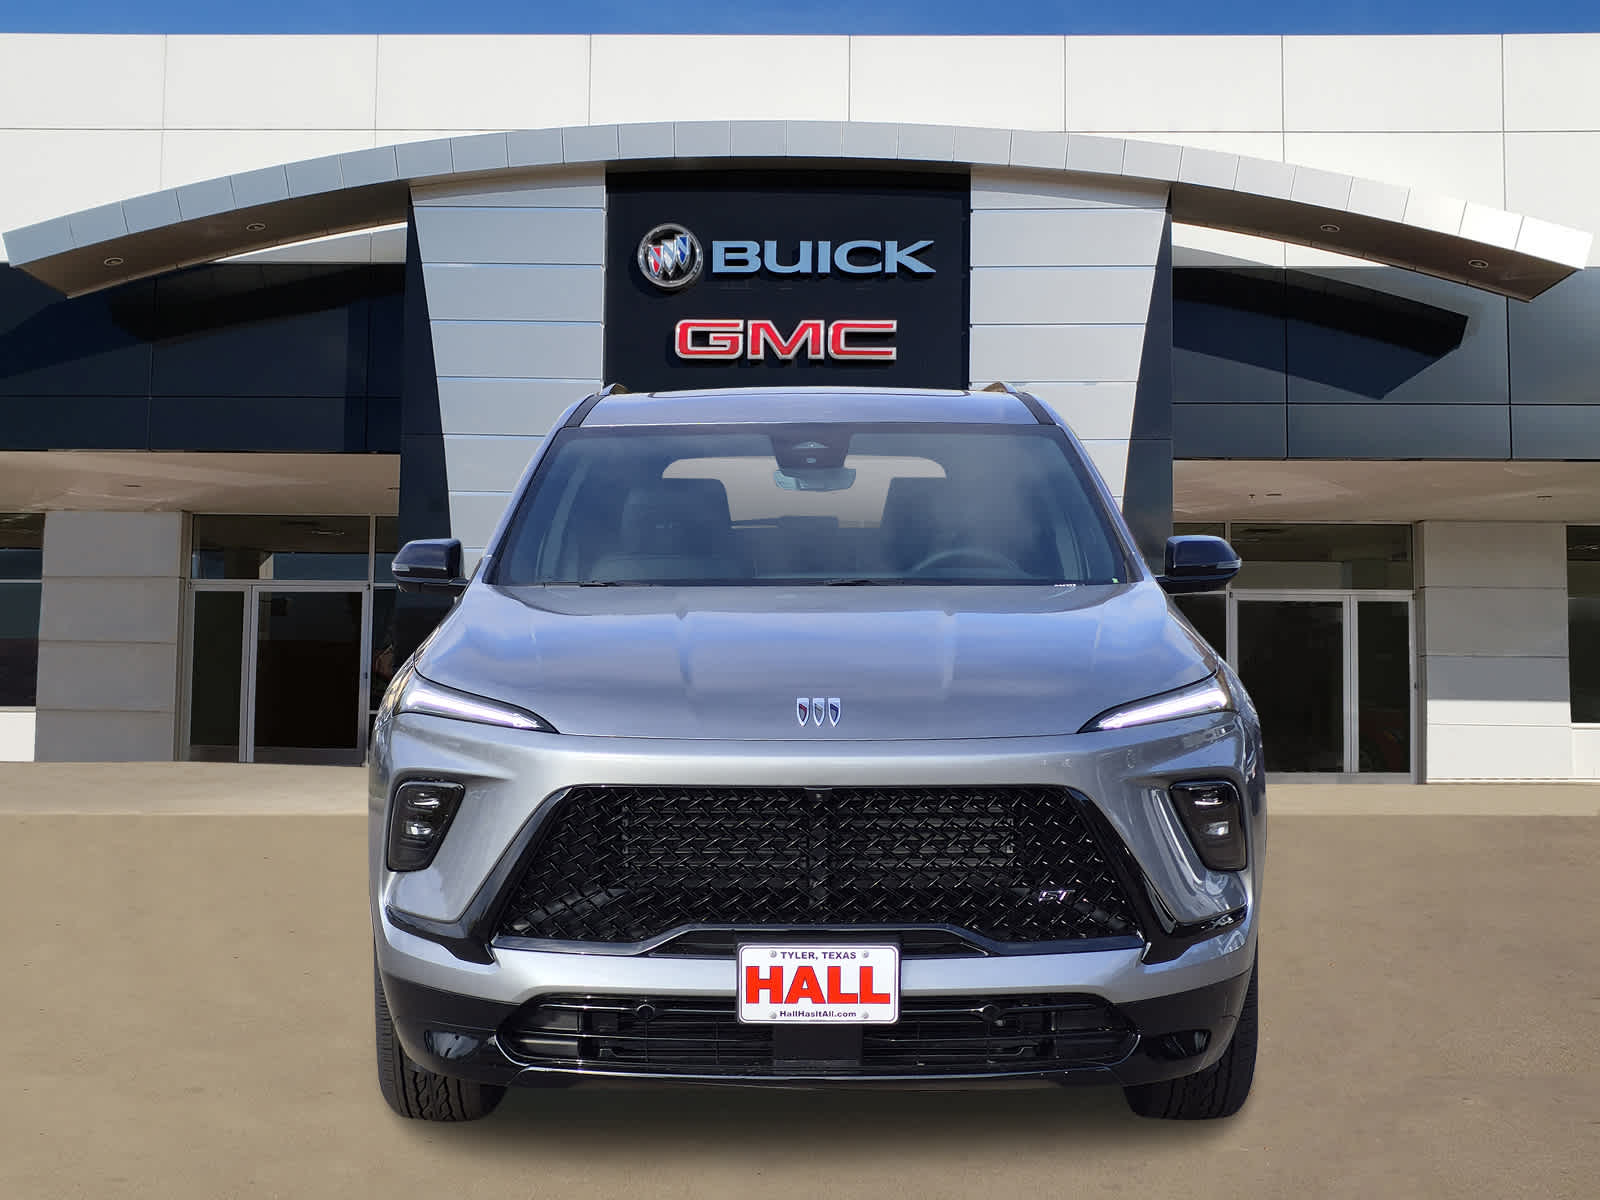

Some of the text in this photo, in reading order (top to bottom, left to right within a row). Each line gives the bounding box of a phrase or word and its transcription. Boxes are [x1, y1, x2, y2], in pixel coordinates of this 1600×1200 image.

[712, 240, 936, 273] BUICK
[675, 319, 897, 360] GMC
[780, 951, 857, 960] TYLER, TEXAS
[745, 966, 890, 1004] HALL
[779, 1010, 857, 1018] HallHasItAll.com
